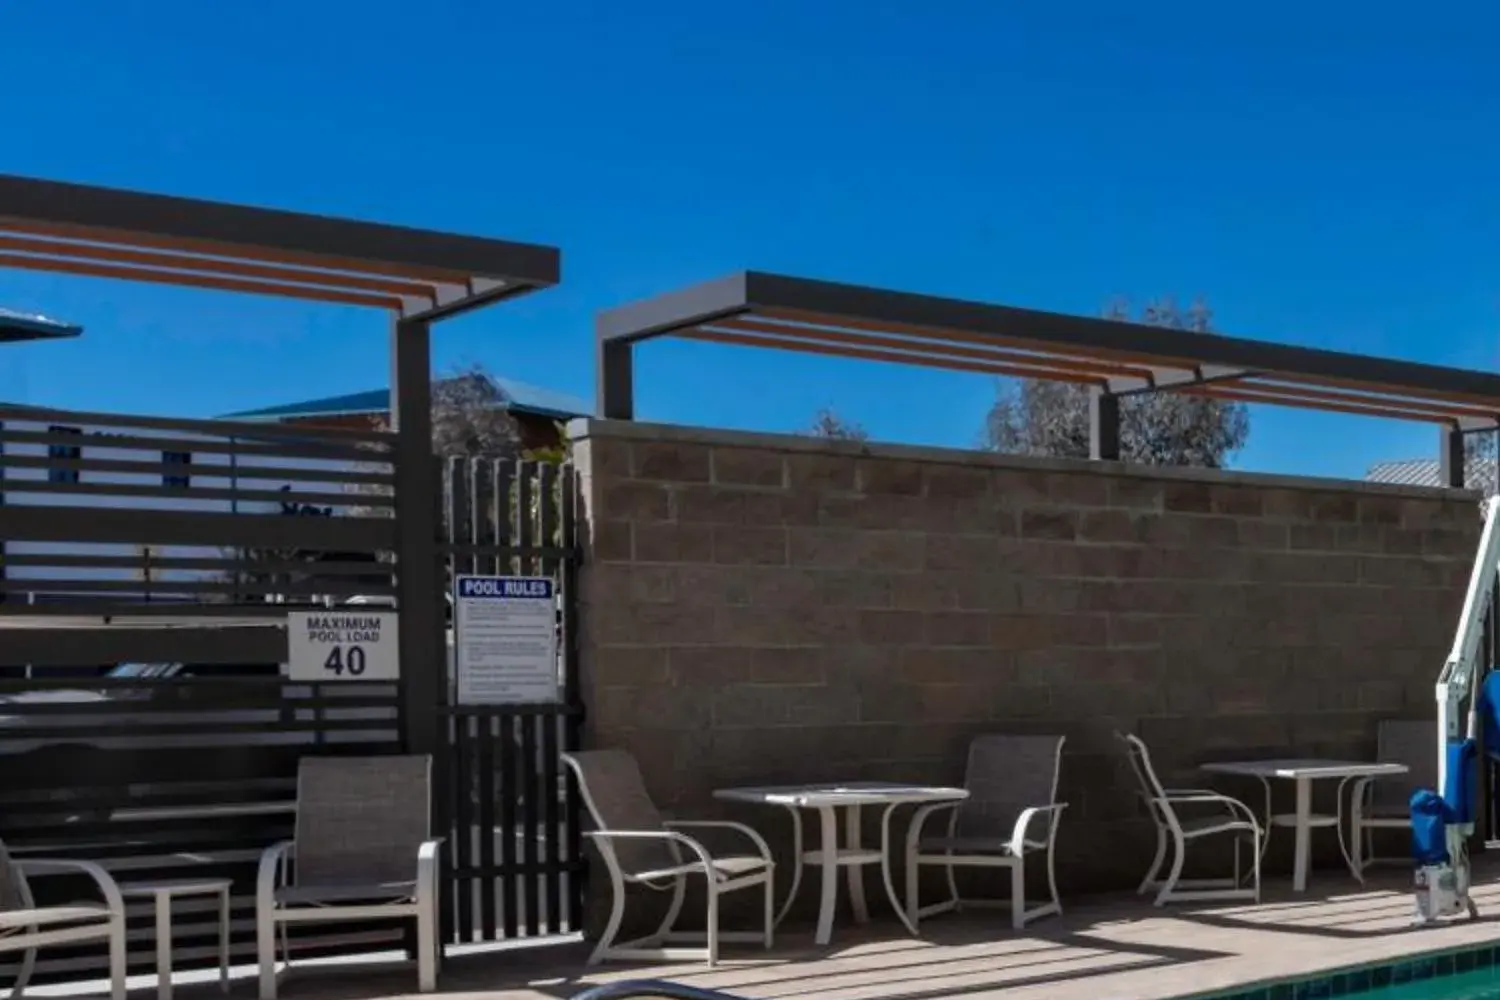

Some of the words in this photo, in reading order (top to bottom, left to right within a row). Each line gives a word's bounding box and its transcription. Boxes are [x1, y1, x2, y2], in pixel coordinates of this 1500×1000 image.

[465, 580, 501, 595] POOL
[504, 580, 547, 595] RULES
[306, 617, 381, 630] MAXIMUM
[308, 631, 343, 642] POOL
[347, 631, 380, 643] LOAD
[324, 646, 366, 675] 40
